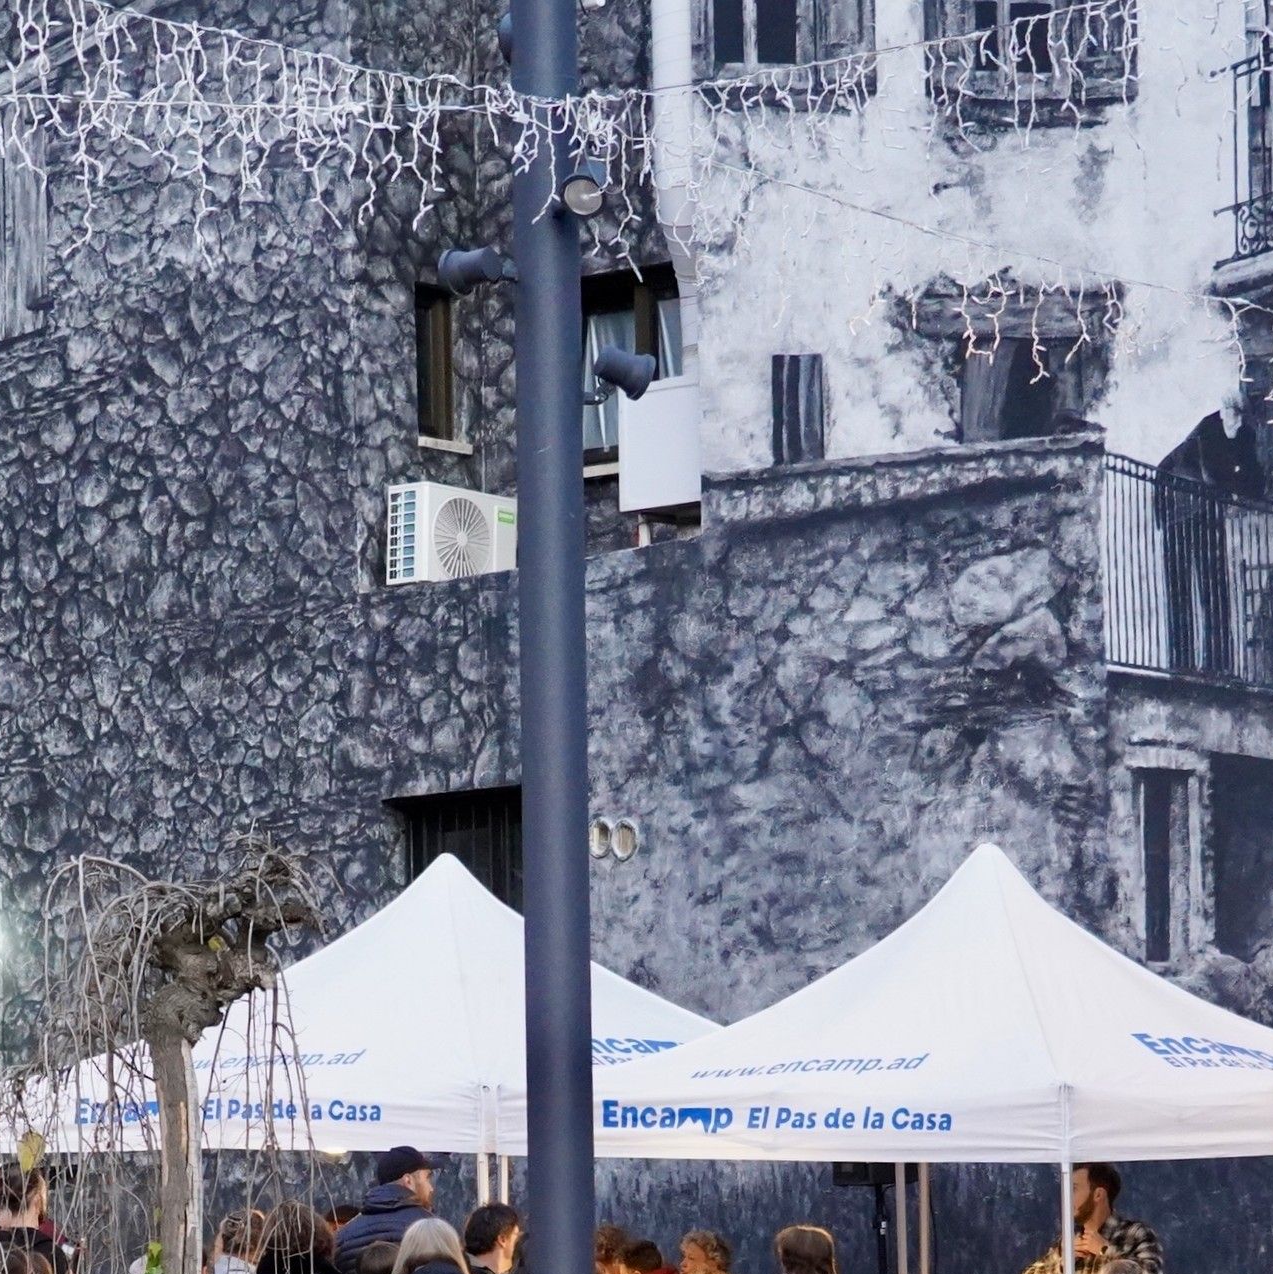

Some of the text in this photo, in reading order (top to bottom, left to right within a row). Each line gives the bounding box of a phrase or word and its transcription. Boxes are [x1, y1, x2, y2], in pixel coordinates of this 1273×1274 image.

[690, 1052, 930, 1080] www.encamp.ad
[227, 1099, 264, 1120] Pas
[271, 1099, 297, 1120] de
[328, 1100, 383, 1122] Casa
[602, 1099, 952, 1134] Encamp El Pas de la Casa
